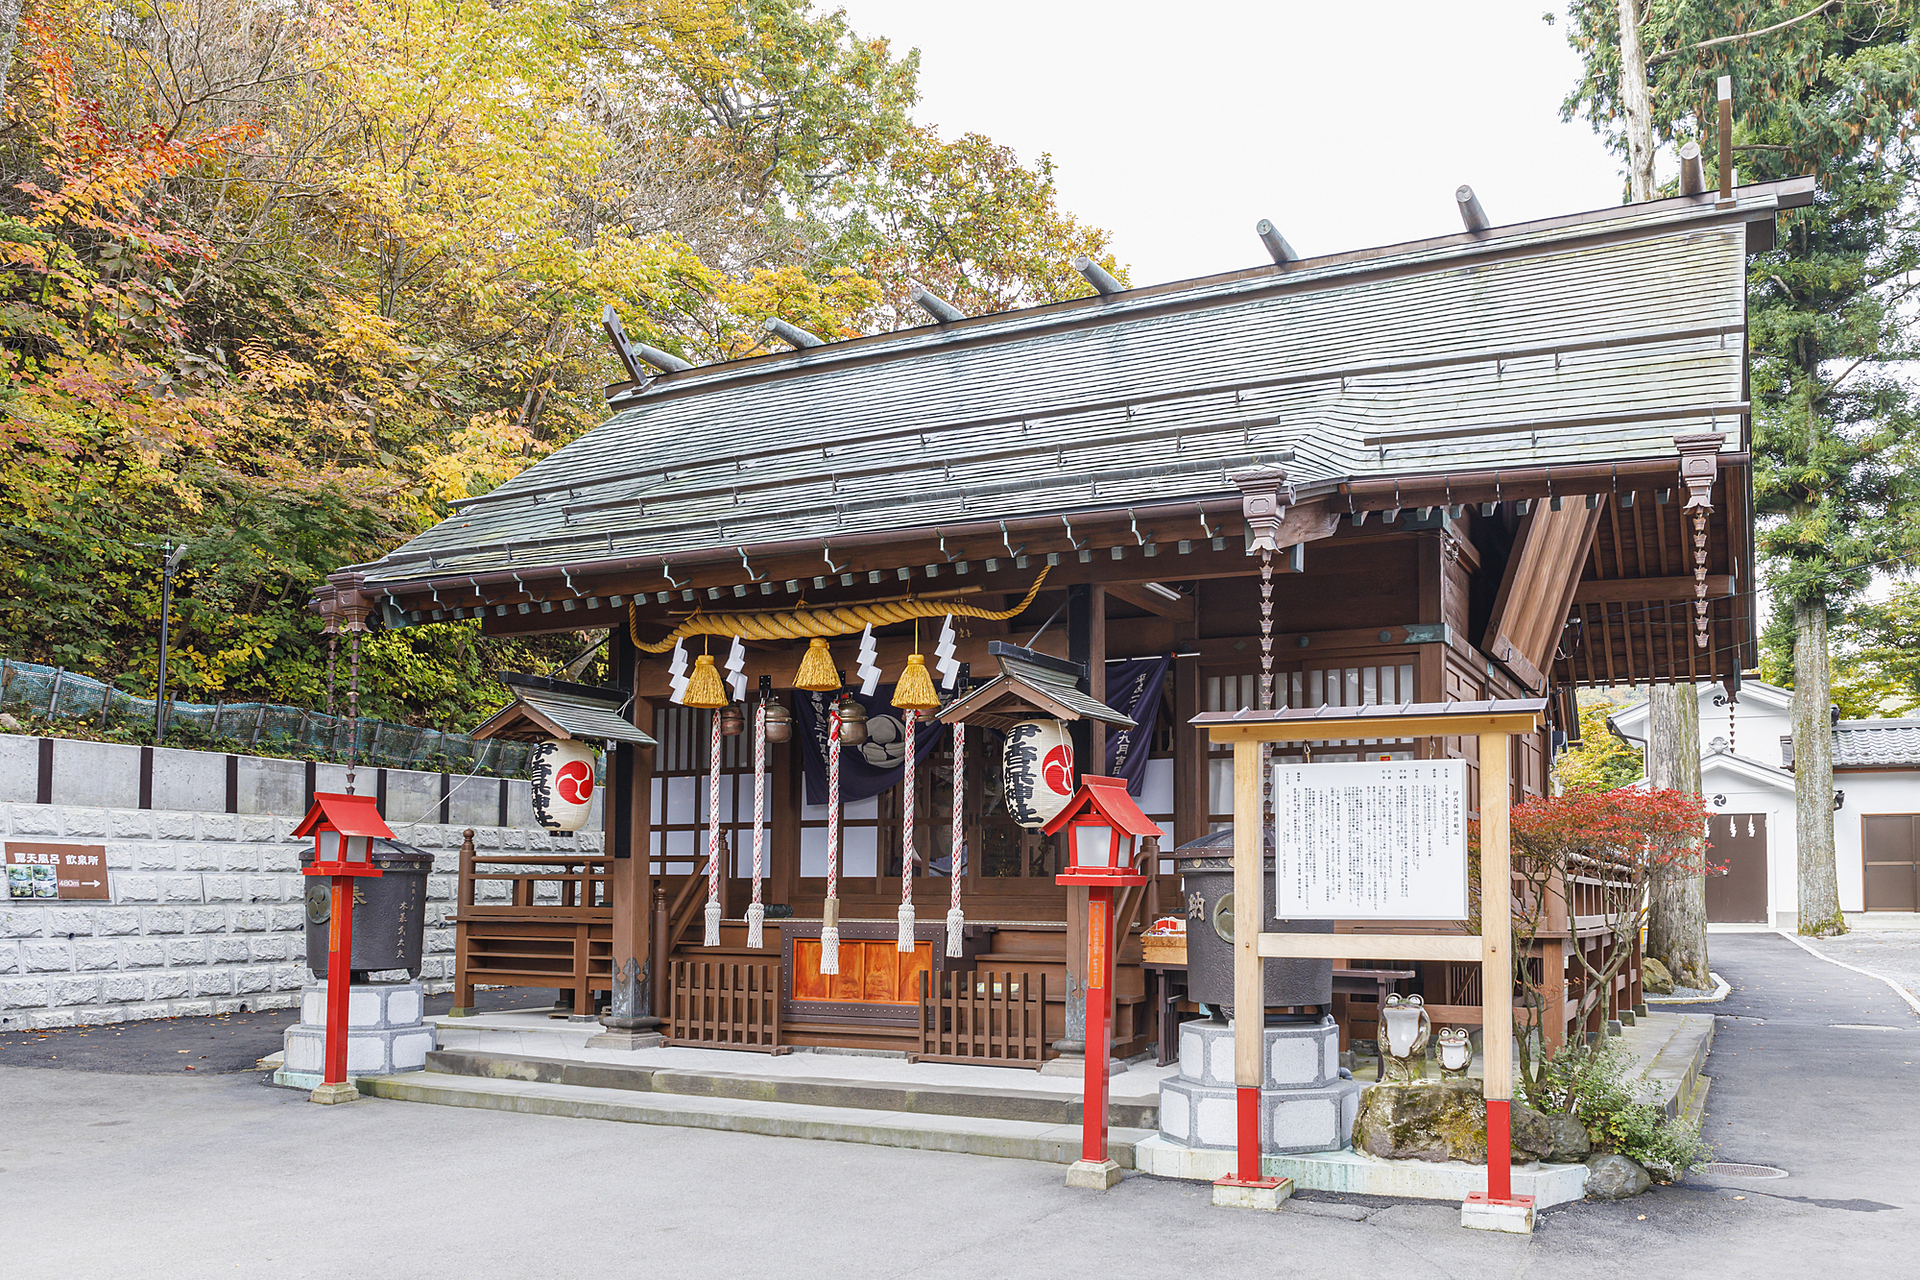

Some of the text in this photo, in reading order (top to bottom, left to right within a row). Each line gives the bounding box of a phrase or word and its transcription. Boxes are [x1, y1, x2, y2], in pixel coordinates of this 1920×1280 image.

[1004, 724, 1044, 824] 伊香保神社
[13, 852, 99, 866] 露天風呂 飲泉所
[1188, 891, 1206, 922] 納
